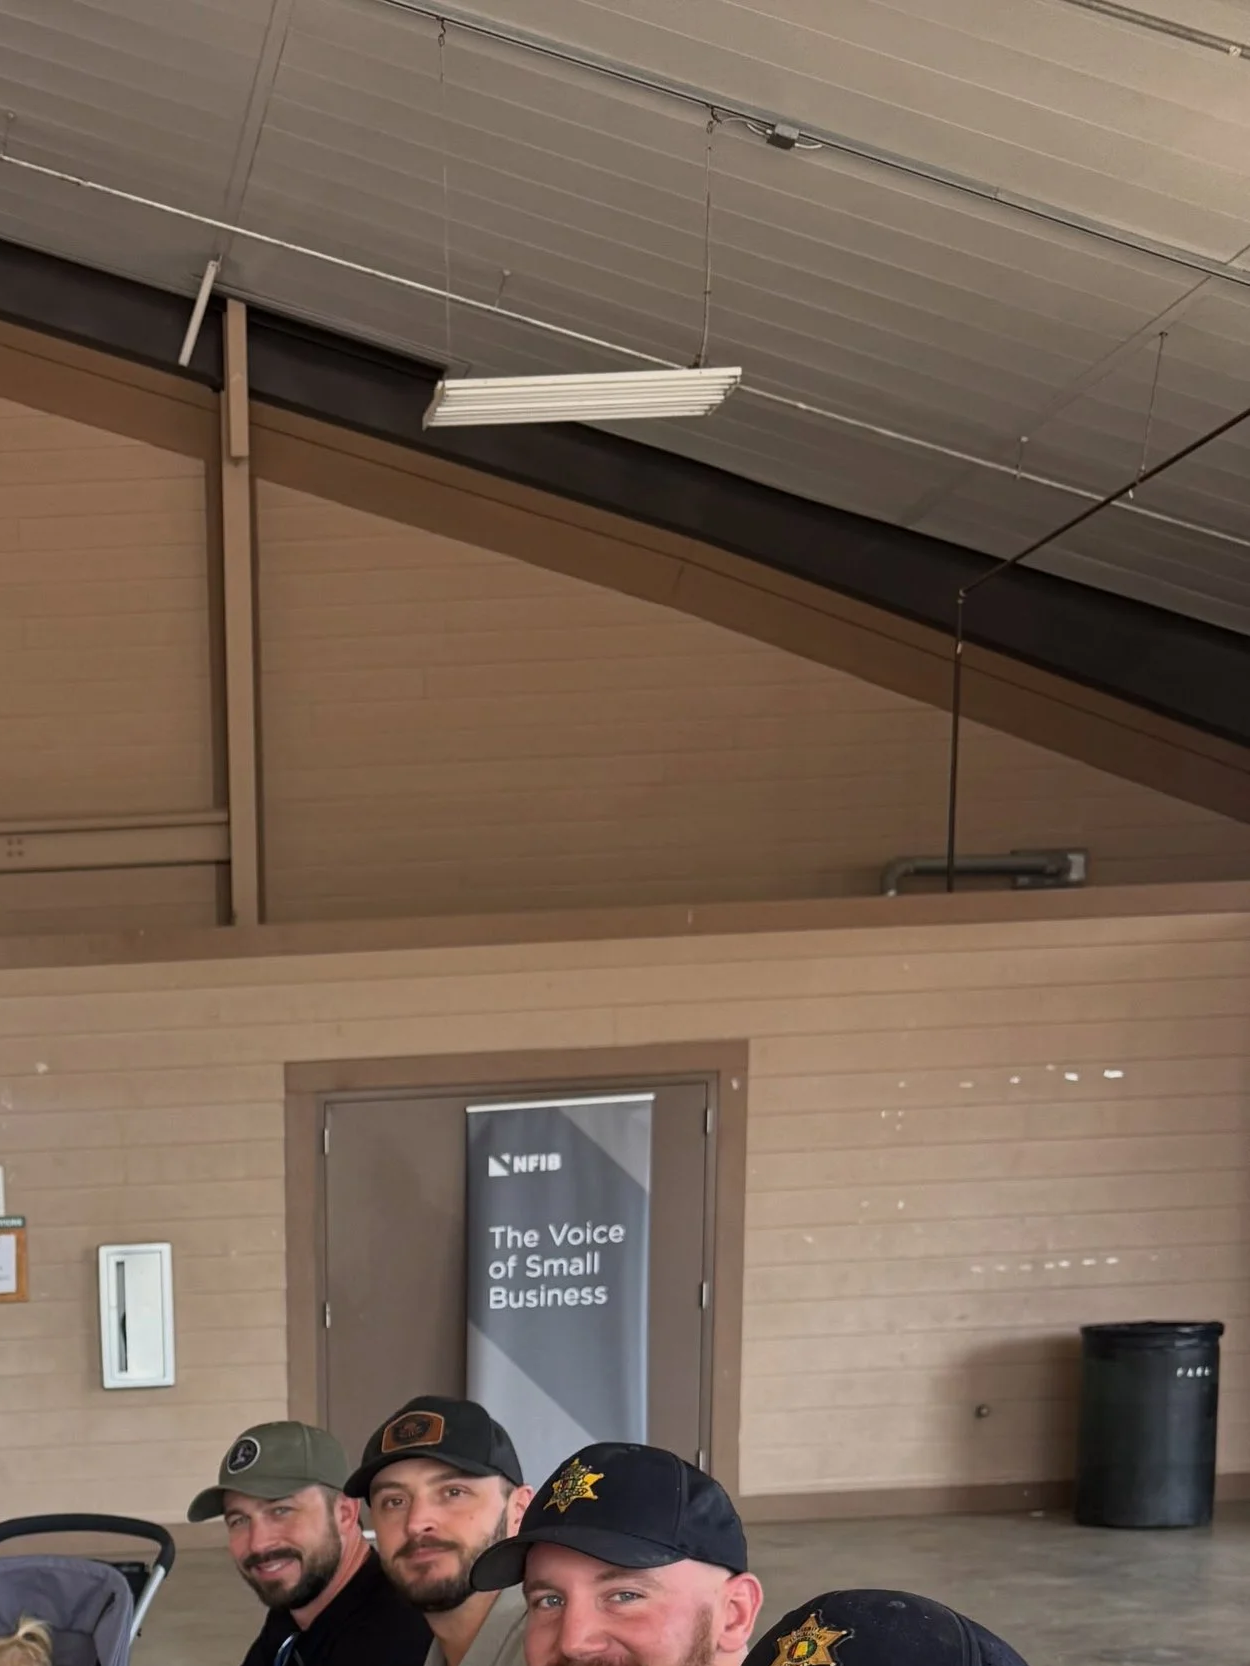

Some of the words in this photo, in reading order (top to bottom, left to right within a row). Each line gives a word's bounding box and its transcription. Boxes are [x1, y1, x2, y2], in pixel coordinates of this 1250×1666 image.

[513, 1153, 562, 1174] NFIB
[489, 1225, 540, 1250] The
[548, 1221, 626, 1246] Voice
[488, 1255, 518, 1280] of
[526, 1251, 600, 1278] Small
[488, 1283, 608, 1310] Business
